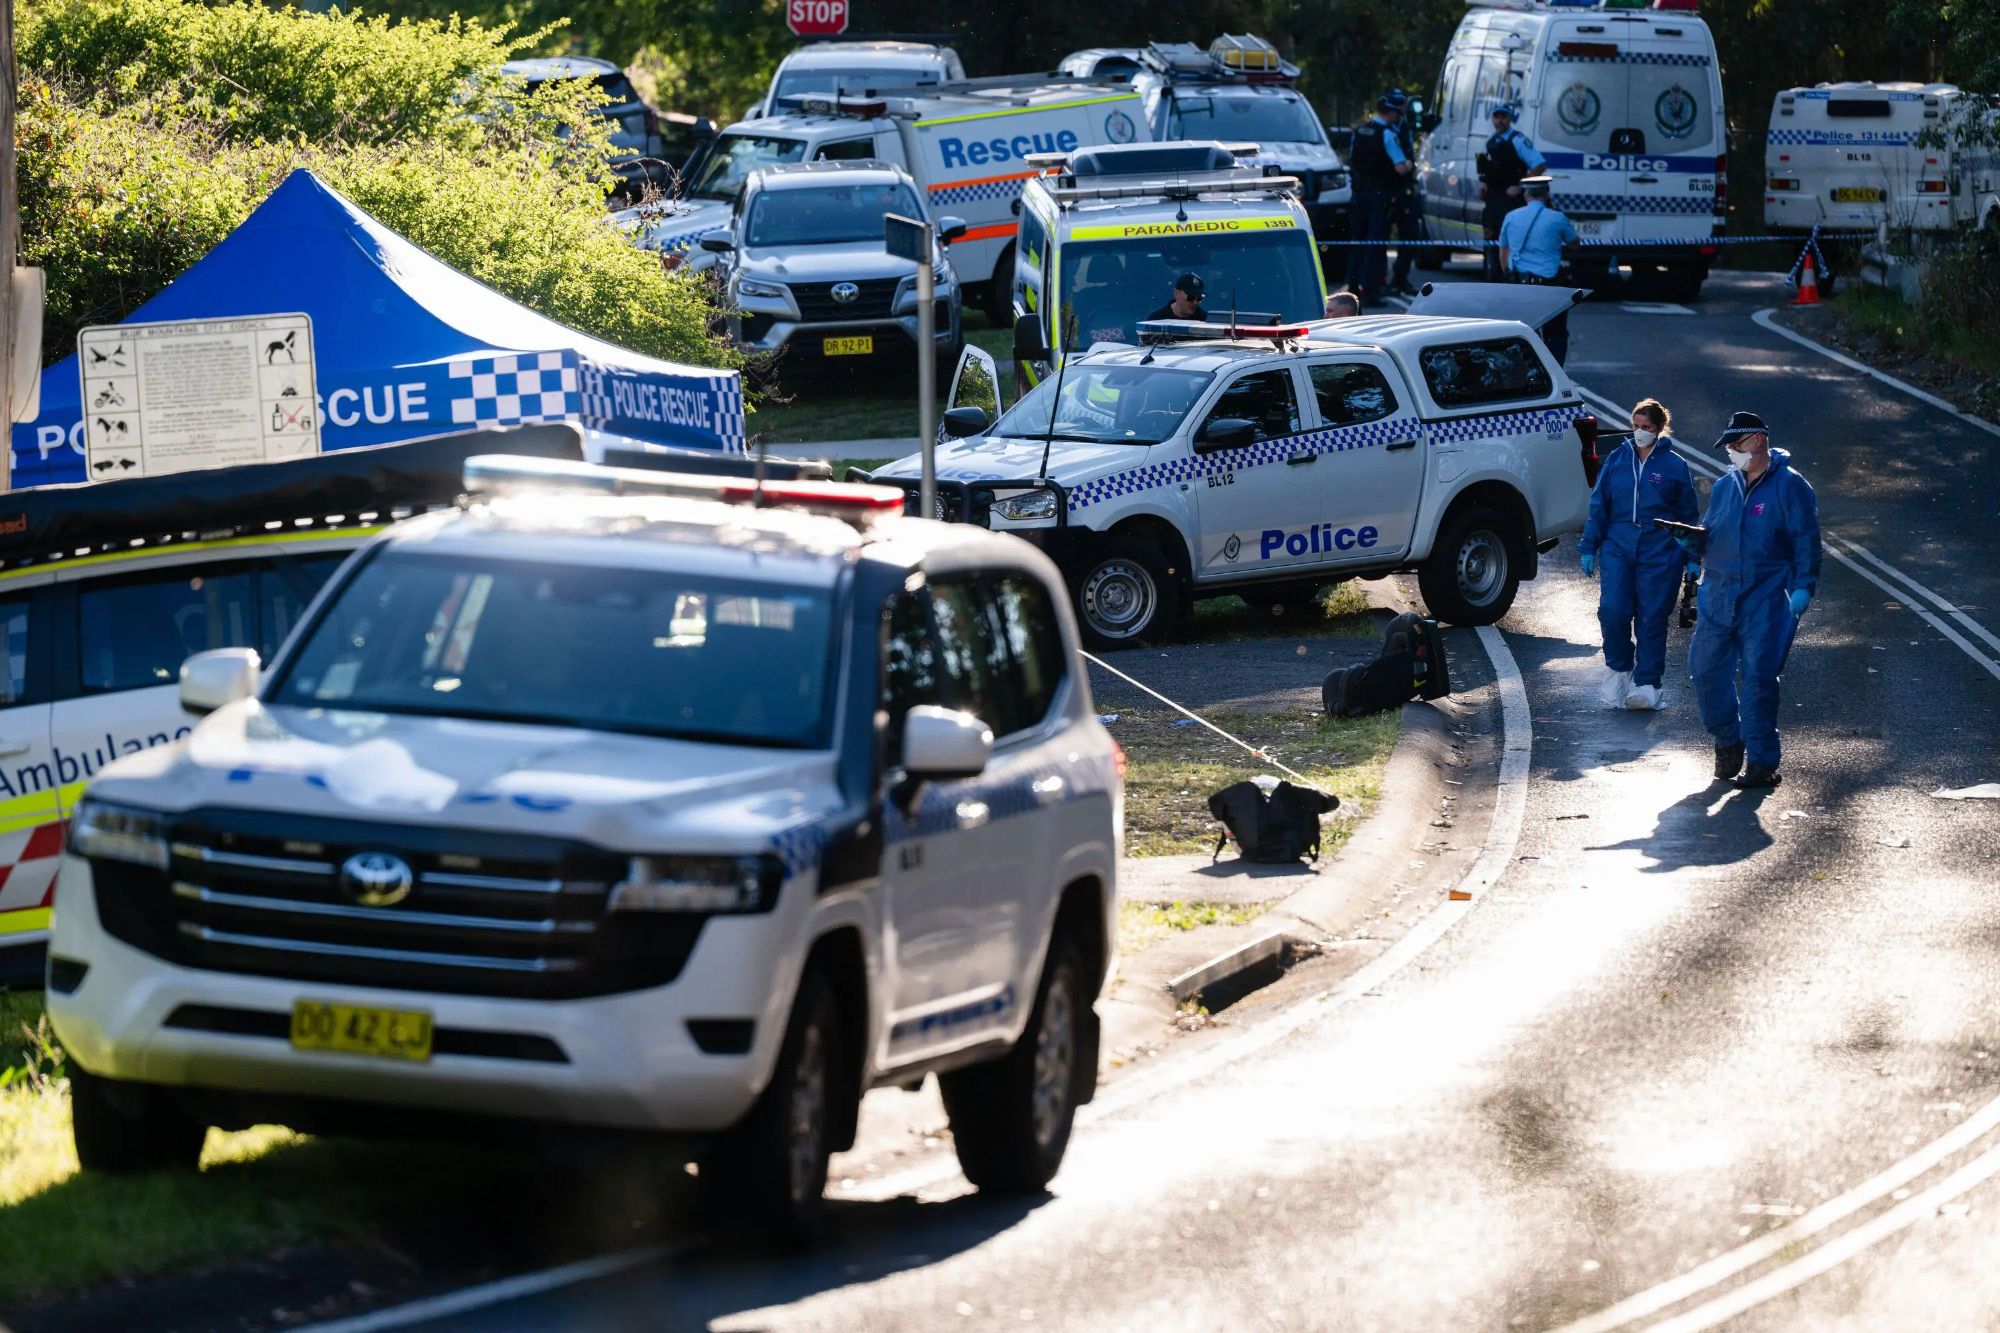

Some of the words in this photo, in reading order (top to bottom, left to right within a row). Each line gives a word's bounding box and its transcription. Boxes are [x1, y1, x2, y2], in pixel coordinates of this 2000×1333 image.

[791, 0, 843, 23] STOP
[1813, 130, 1853, 140] Police
[1861, 131, 1878, 140] 131
[1881, 131, 1900, 140] 444
[939, 130, 1078, 168] Rescue
[1582, 154, 1669, 171] Police
[1124, 221, 1239, 236] PARAMEDIC
[1263, 220, 1294, 228] 1391
[825, 341, 839, 352] DR
[842, 340, 855, 351] 92
[612, 379, 661, 421] POLICE
[659, 388, 711, 428] RESCUE
[1546, 420, 1562, 433] 000
[1208, 474, 1235, 488] BL12
[1261, 523, 1379, 560] Police
